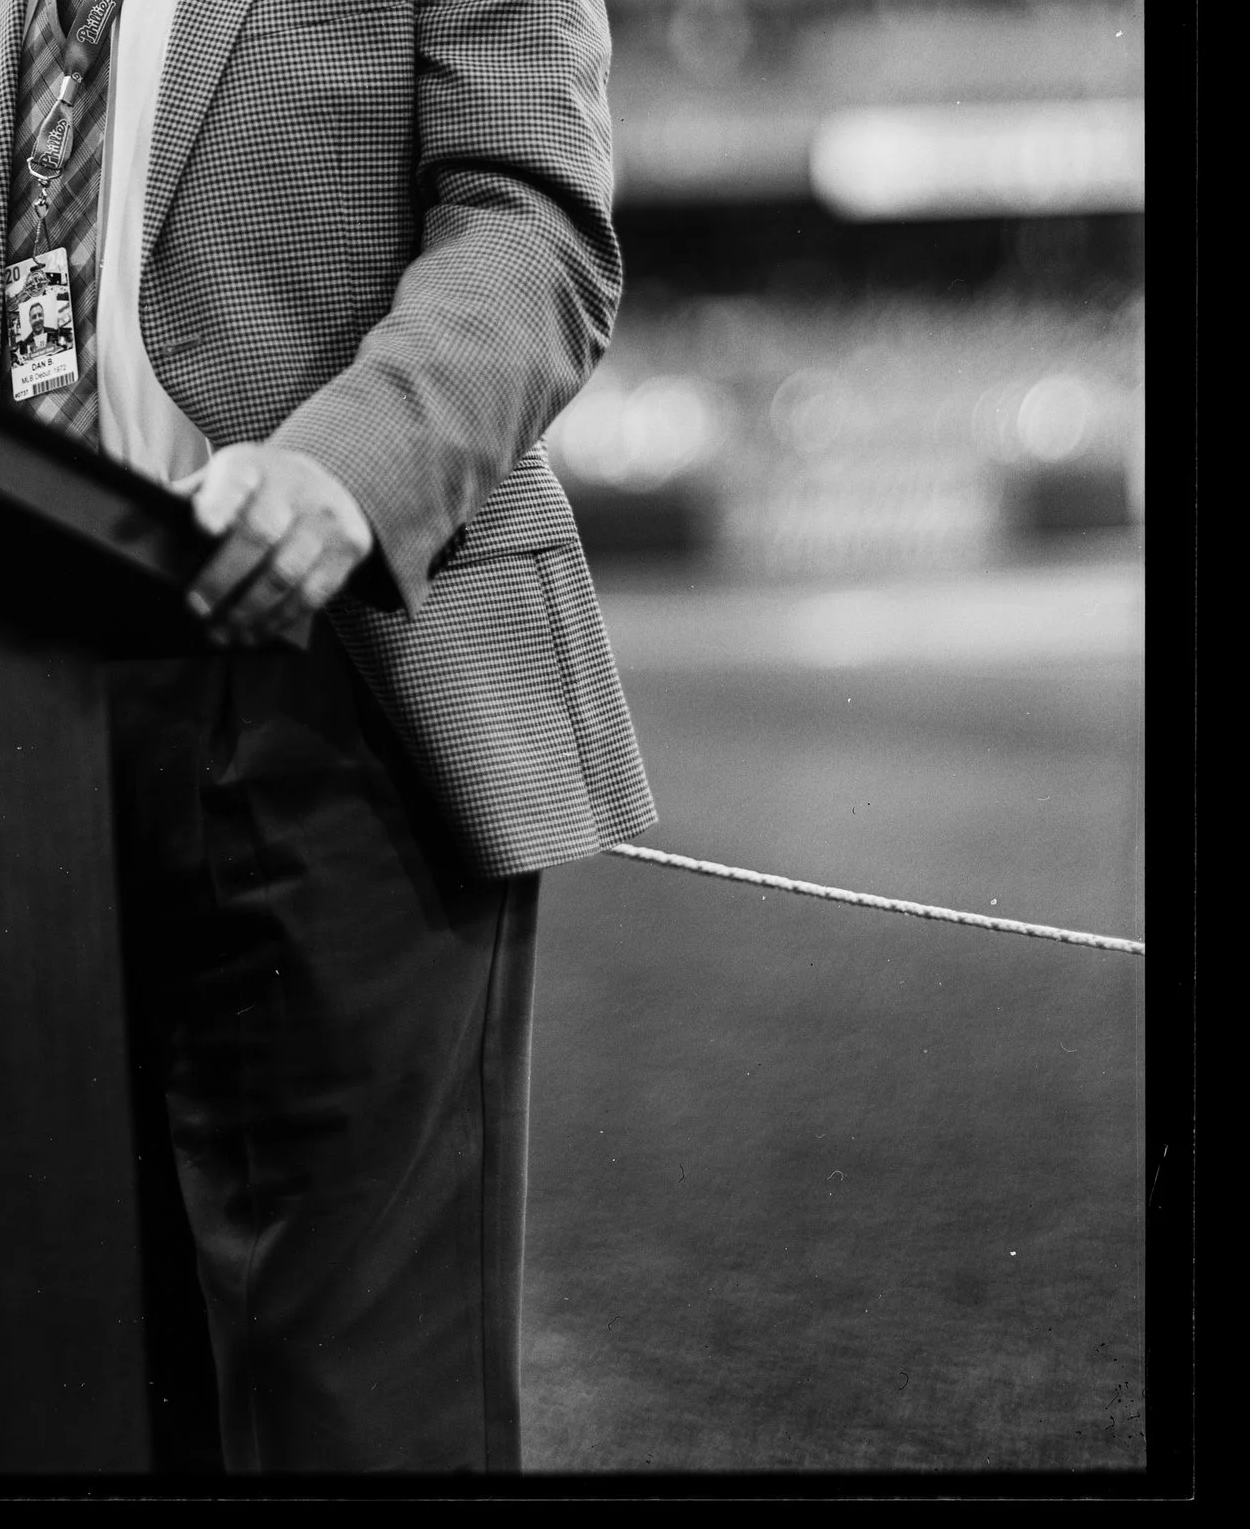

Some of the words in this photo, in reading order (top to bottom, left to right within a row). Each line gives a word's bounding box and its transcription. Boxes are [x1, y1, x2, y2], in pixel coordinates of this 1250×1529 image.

[38, 118, 70, 170] Phillies
[32, 361, 46, 371] DAN
[22, 375, 34, 384] MLB
